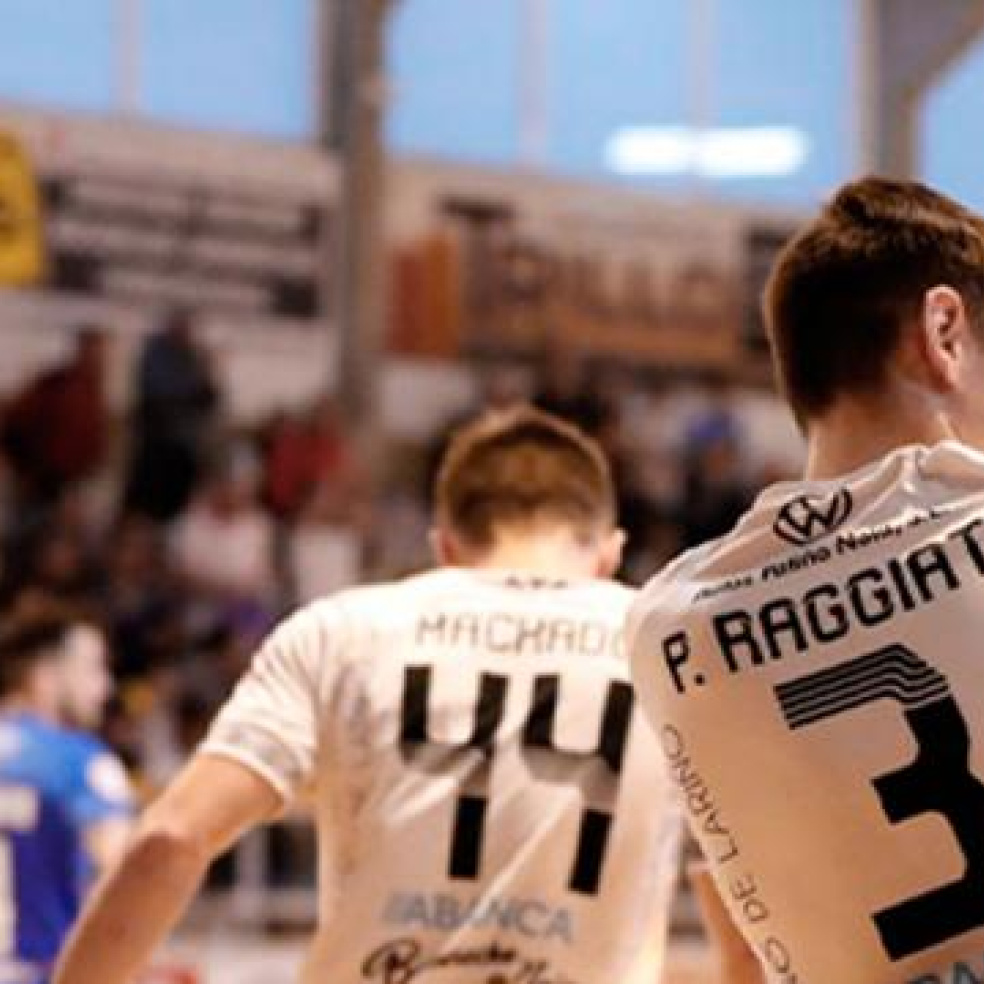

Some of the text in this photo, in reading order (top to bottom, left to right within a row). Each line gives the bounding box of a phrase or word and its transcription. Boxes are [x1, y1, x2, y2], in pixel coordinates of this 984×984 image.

[662, 630, 705, 694] P.
[401, 663, 634, 896] 44
[729, 874, 769, 924] DE
